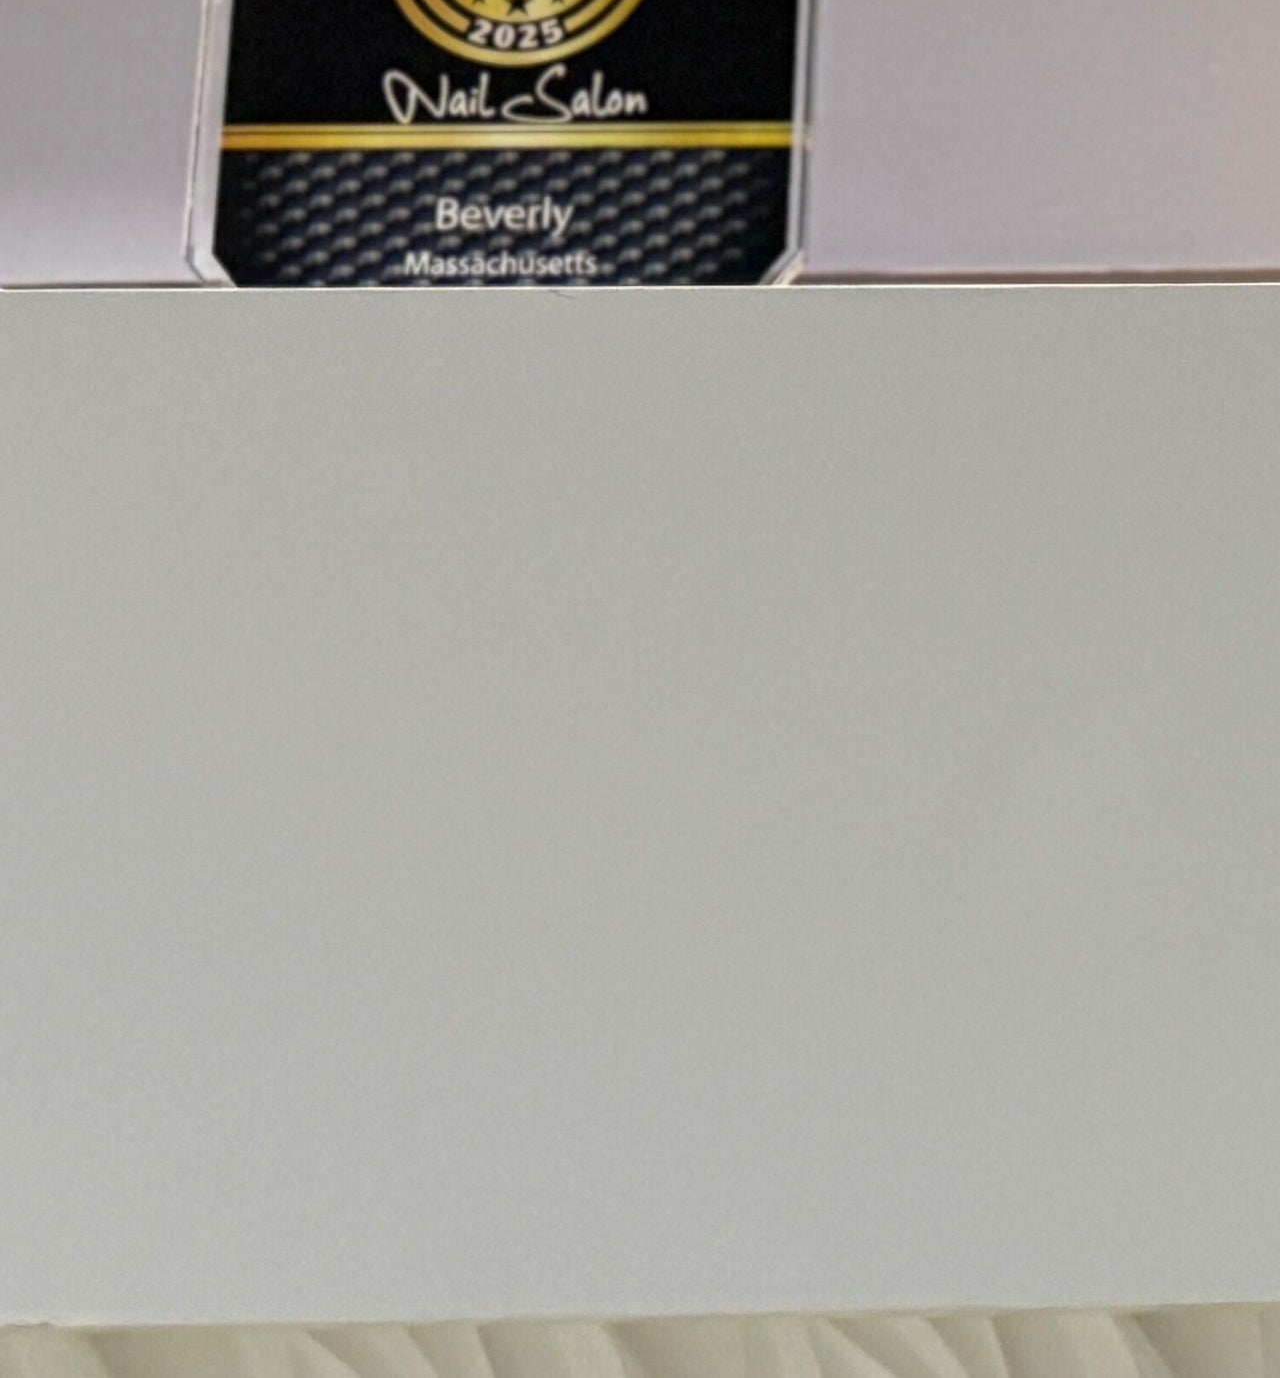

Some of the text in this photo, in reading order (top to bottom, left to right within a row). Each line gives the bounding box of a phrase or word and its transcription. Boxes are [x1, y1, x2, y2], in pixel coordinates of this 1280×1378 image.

[467, 18, 566, 49] 2025
[382, 64, 648, 124] Nail Salon
[435, 196, 574, 239] Beverly
[404, 250, 598, 276] Massachusetts
